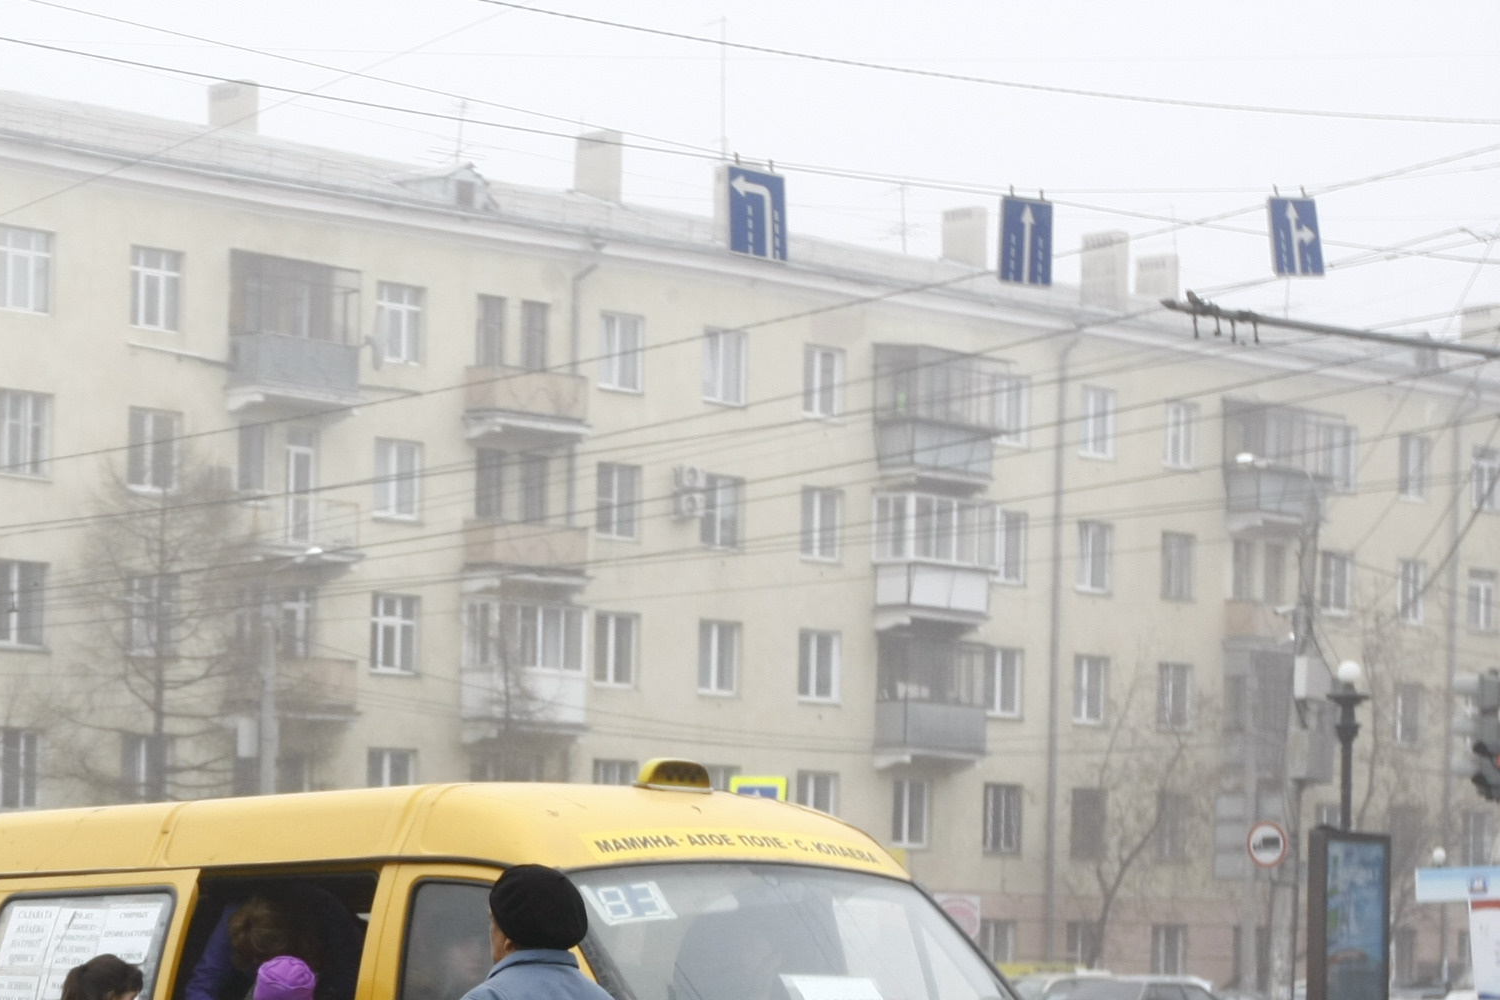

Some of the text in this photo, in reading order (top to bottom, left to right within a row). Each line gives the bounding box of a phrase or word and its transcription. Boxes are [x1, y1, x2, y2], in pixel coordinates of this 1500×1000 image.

[595, 836, 677, 853] МАМИНА
[686, 833, 736, 846] АЛОЕ
[737, 835, 785, 850] ПОЛЕ
[812, 842, 881, 864] ЮЛАЕВА
